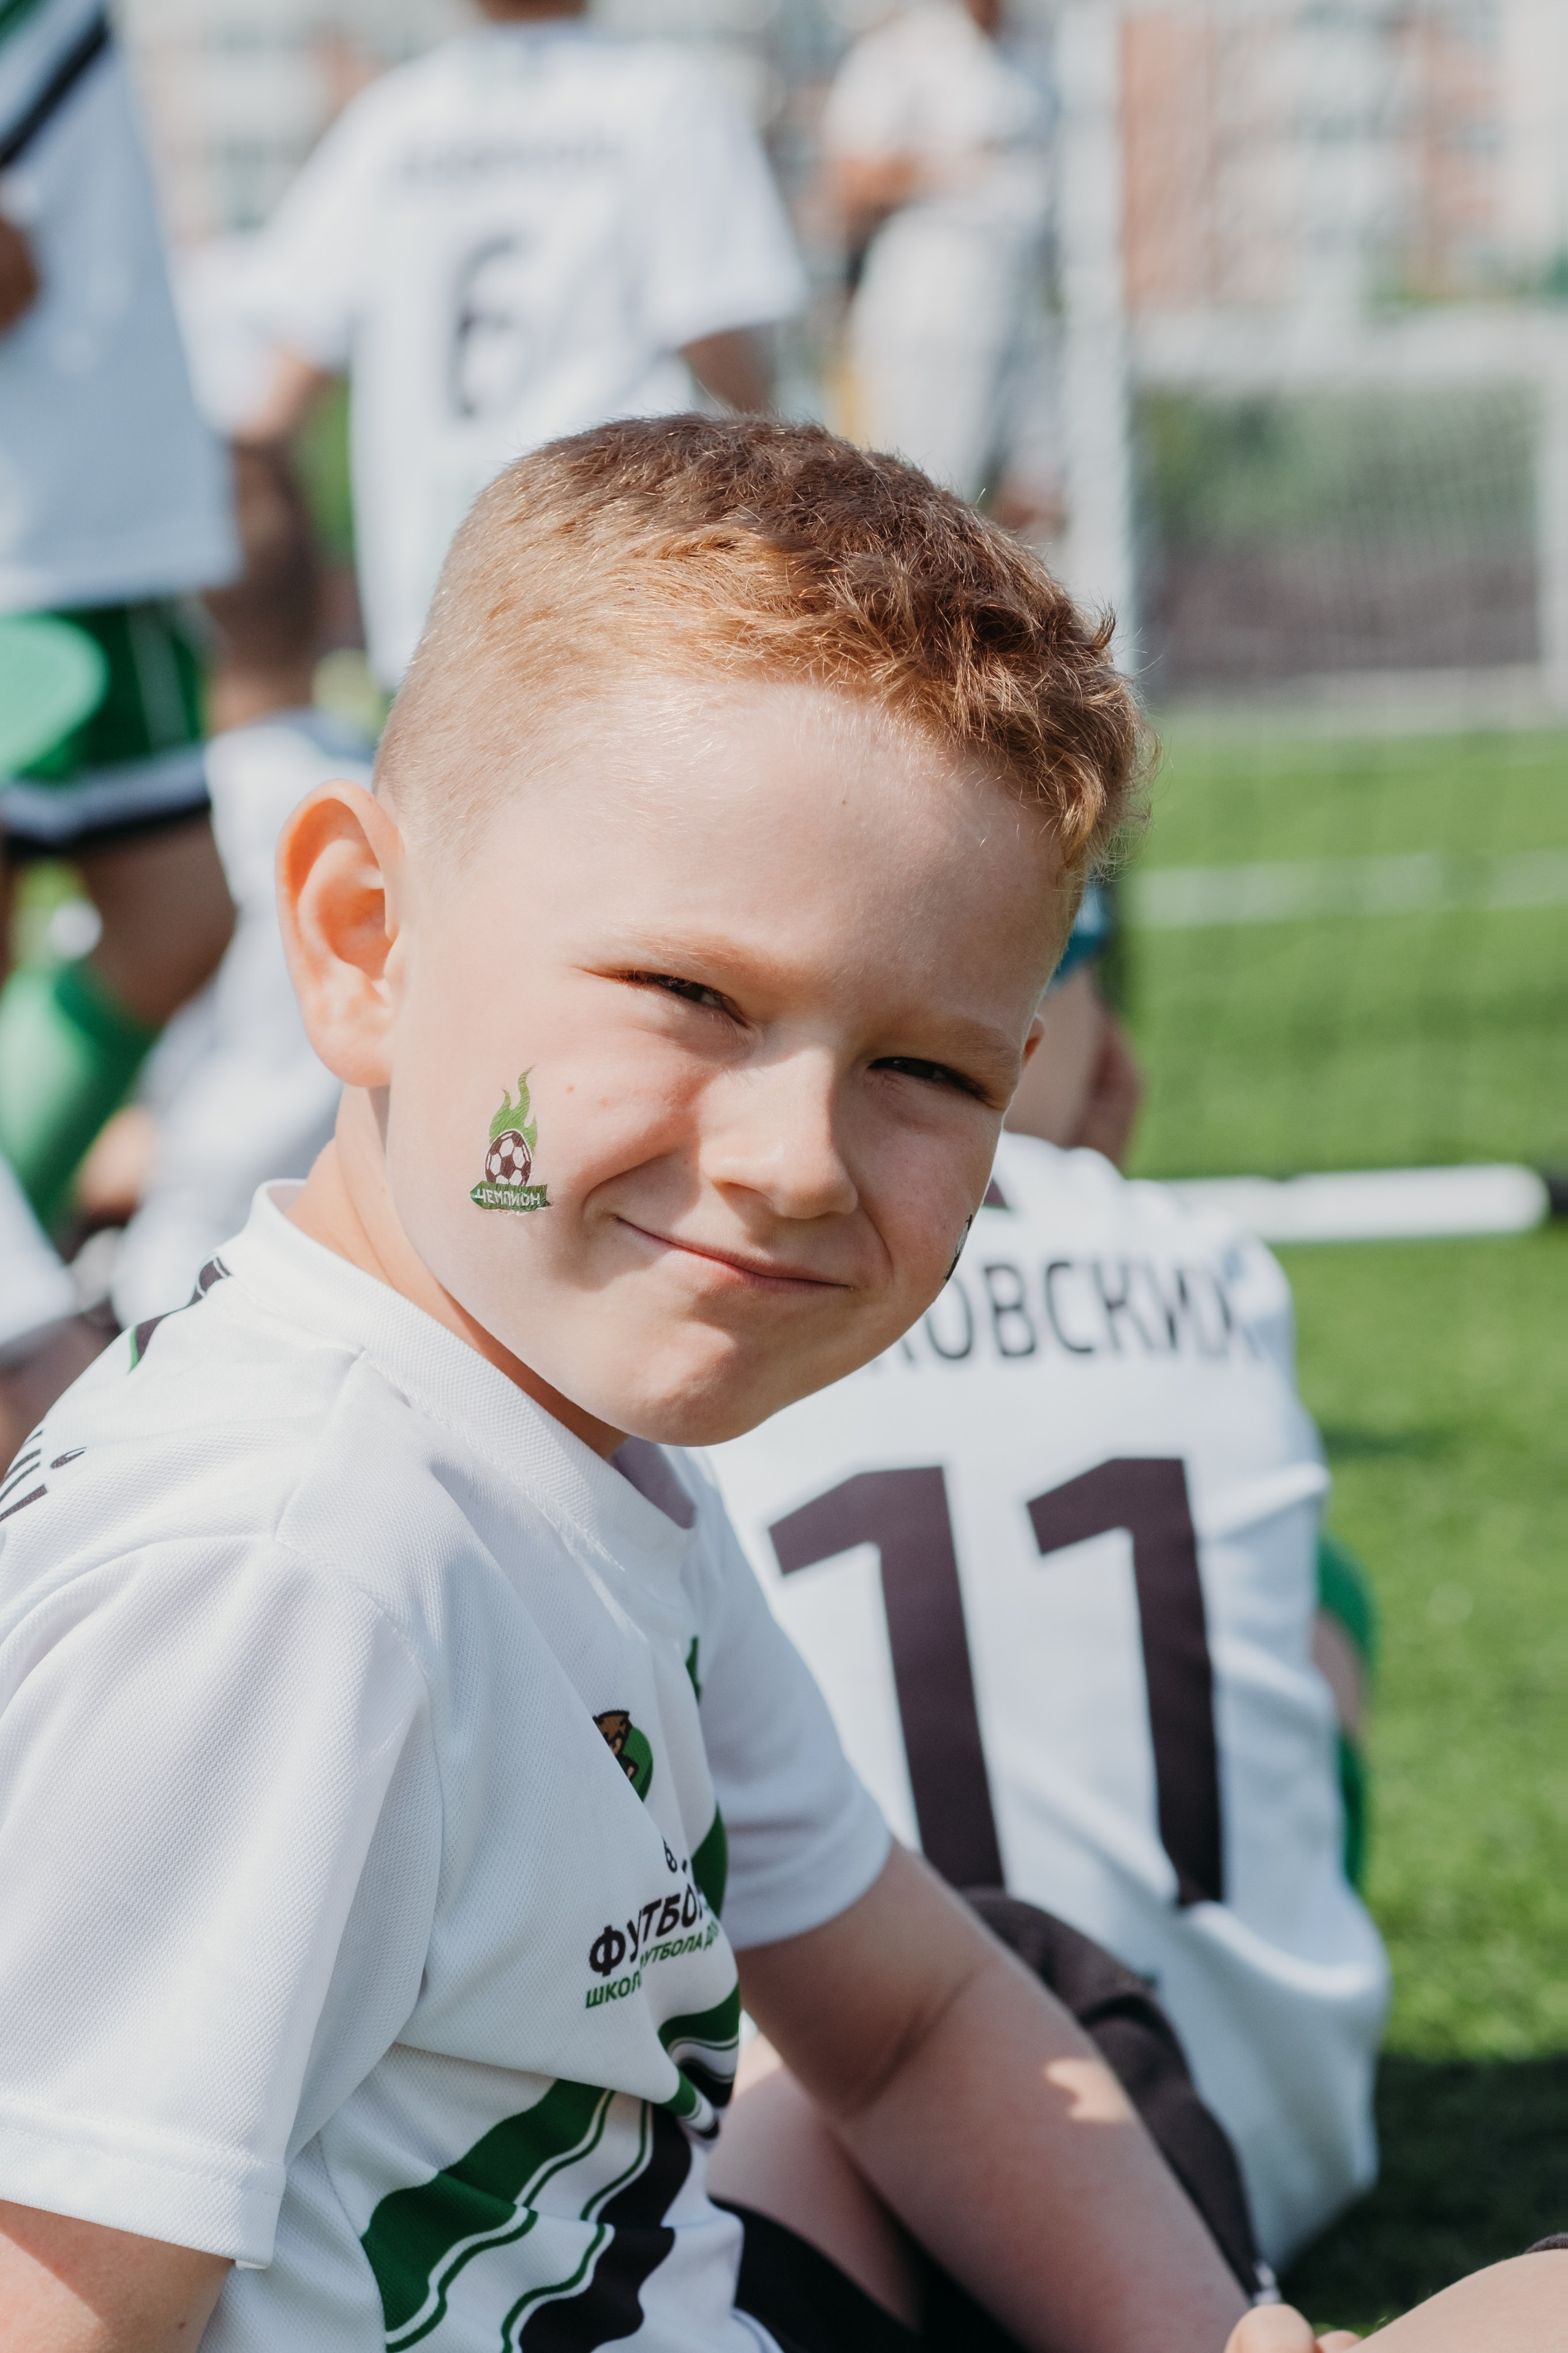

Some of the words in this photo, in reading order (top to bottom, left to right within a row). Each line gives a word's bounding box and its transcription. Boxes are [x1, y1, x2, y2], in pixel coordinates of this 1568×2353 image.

[474, 1188, 540, 1206] ЧЕМПИОН
[869, 1260, 1263, 1362] ОВСКИХ
[767, 1456, 1226, 1908] 11
[589, 1883, 703, 1977] ФУТБО
[640, 1932, 703, 1969] УТБОЛА
